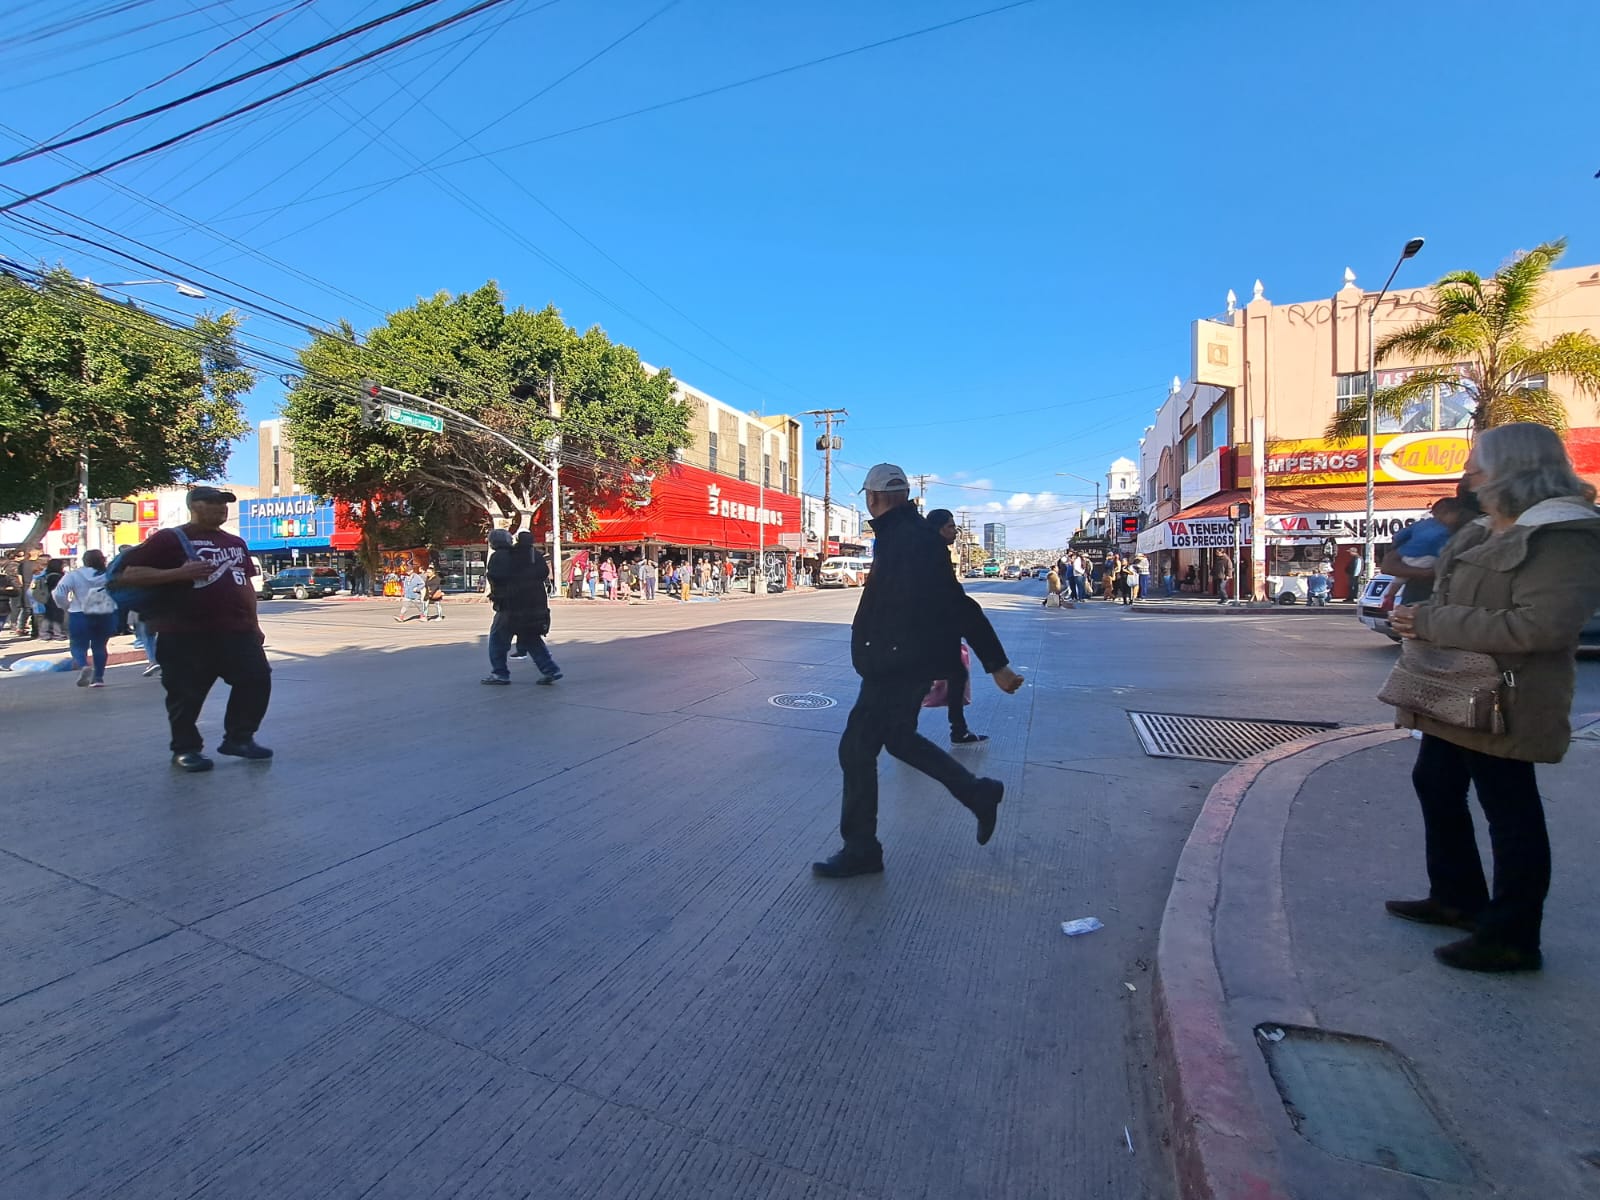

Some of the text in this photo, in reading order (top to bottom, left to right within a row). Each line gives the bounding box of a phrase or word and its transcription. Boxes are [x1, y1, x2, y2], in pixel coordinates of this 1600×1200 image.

[1264, 452, 1359, 473] MPEÑOS
[1424, 442, 1466, 471] Mejo
[1168, 522, 1188, 535] YA
[1188, 523, 1241, 535] TENEMO
[1280, 517, 1313, 540] YA
[1172, 536, 1191, 547] LOS
[1192, 535, 1227, 547] PRECIOS
